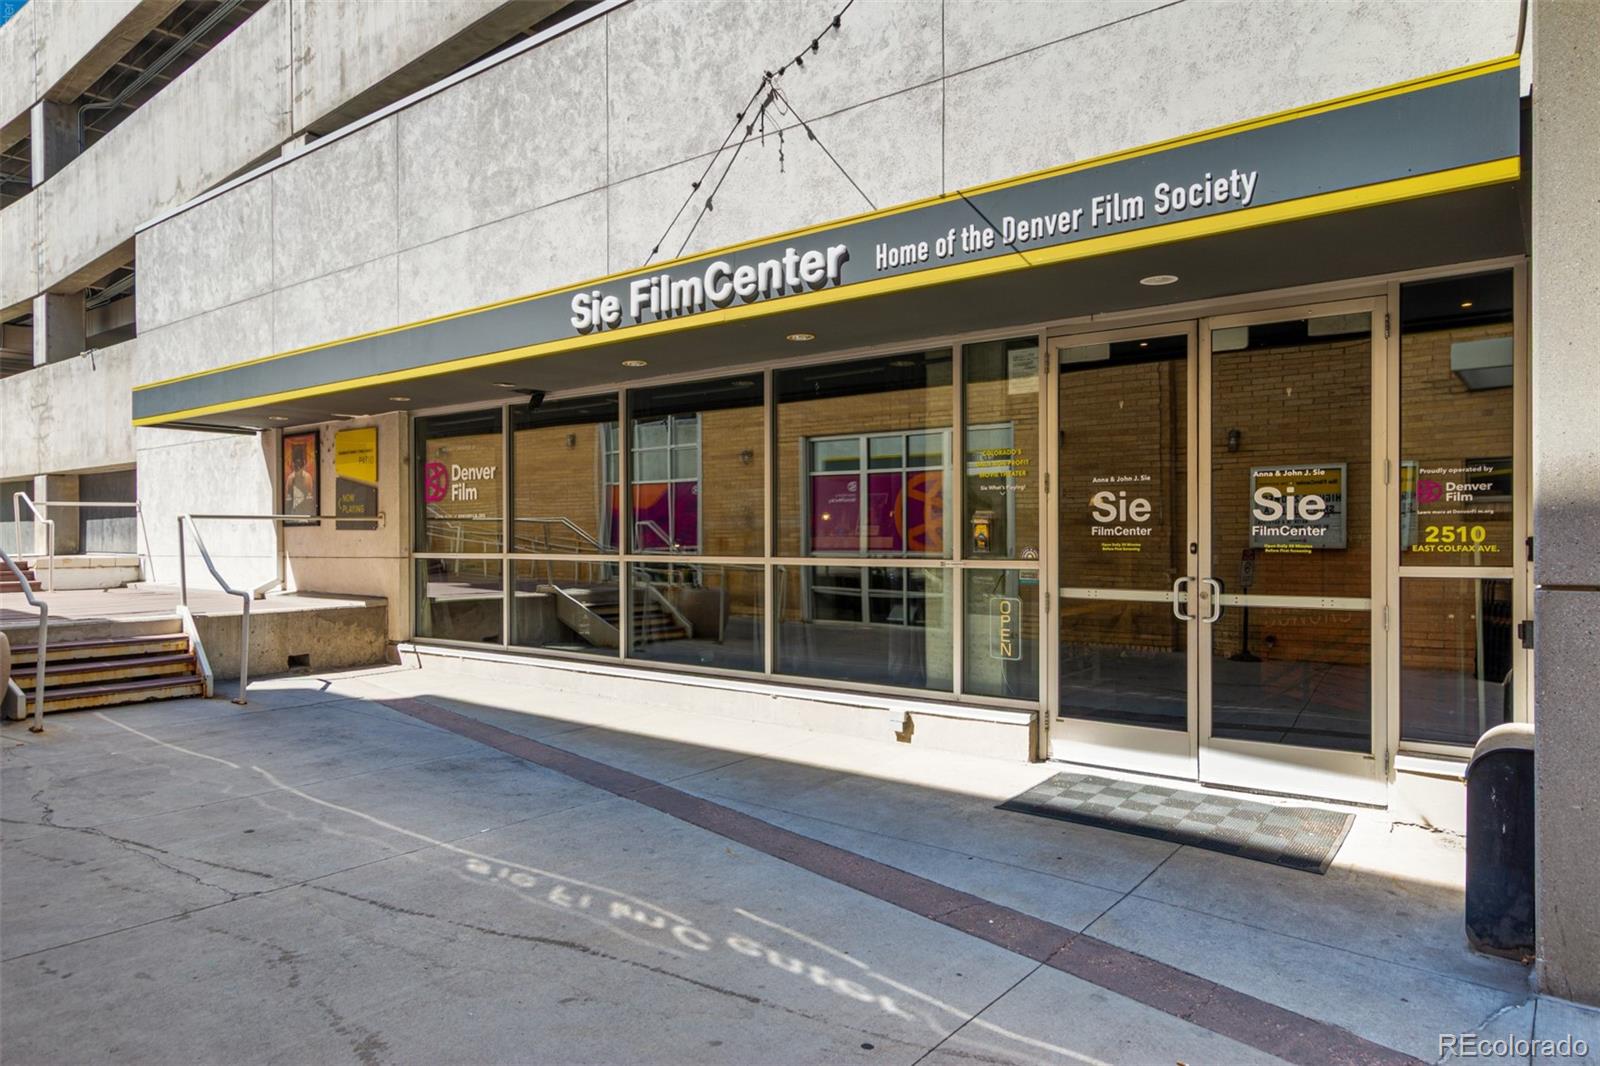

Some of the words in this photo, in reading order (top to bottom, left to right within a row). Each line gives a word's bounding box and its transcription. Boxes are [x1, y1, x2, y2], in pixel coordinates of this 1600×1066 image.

[875, 243, 930, 270] Home
[935, 230, 957, 260] of
[961, 224, 995, 250] the
[1002, 208, 1084, 246] Denver
[1091, 192, 1145, 229] Film
[1154, 168, 1259, 216] Society
[571, 291, 621, 332] Sie
[630, 244, 849, 318] FilmCenter
[451, 464, 496, 482] Denver
[1283, 469, 1303, 477] John
[1313, 468, 1326, 476] Sie
[1419, 468, 1447, 476] Proudly
[1448, 466, 1482, 474] operated
[1483, 465, 1494, 473] by
[451, 482, 478, 501] Film
[1445, 481, 1493, 492] Denver
[1252, 486, 1326, 522] Sie
[1445, 491, 1473, 502] Film
[1091, 490, 1152, 523] Sie
[1091, 526, 1152, 537] FilmCenter
[1252, 525, 1327, 537] FilmCenter
[1425, 525, 1487, 543] 2510
[1412, 544, 1436, 552] EAST
[1437, 544, 1476, 552] COLFAX
[1477, 544, 1500, 552] AVE.
[1000, 600, 1012, 657] OPEN
